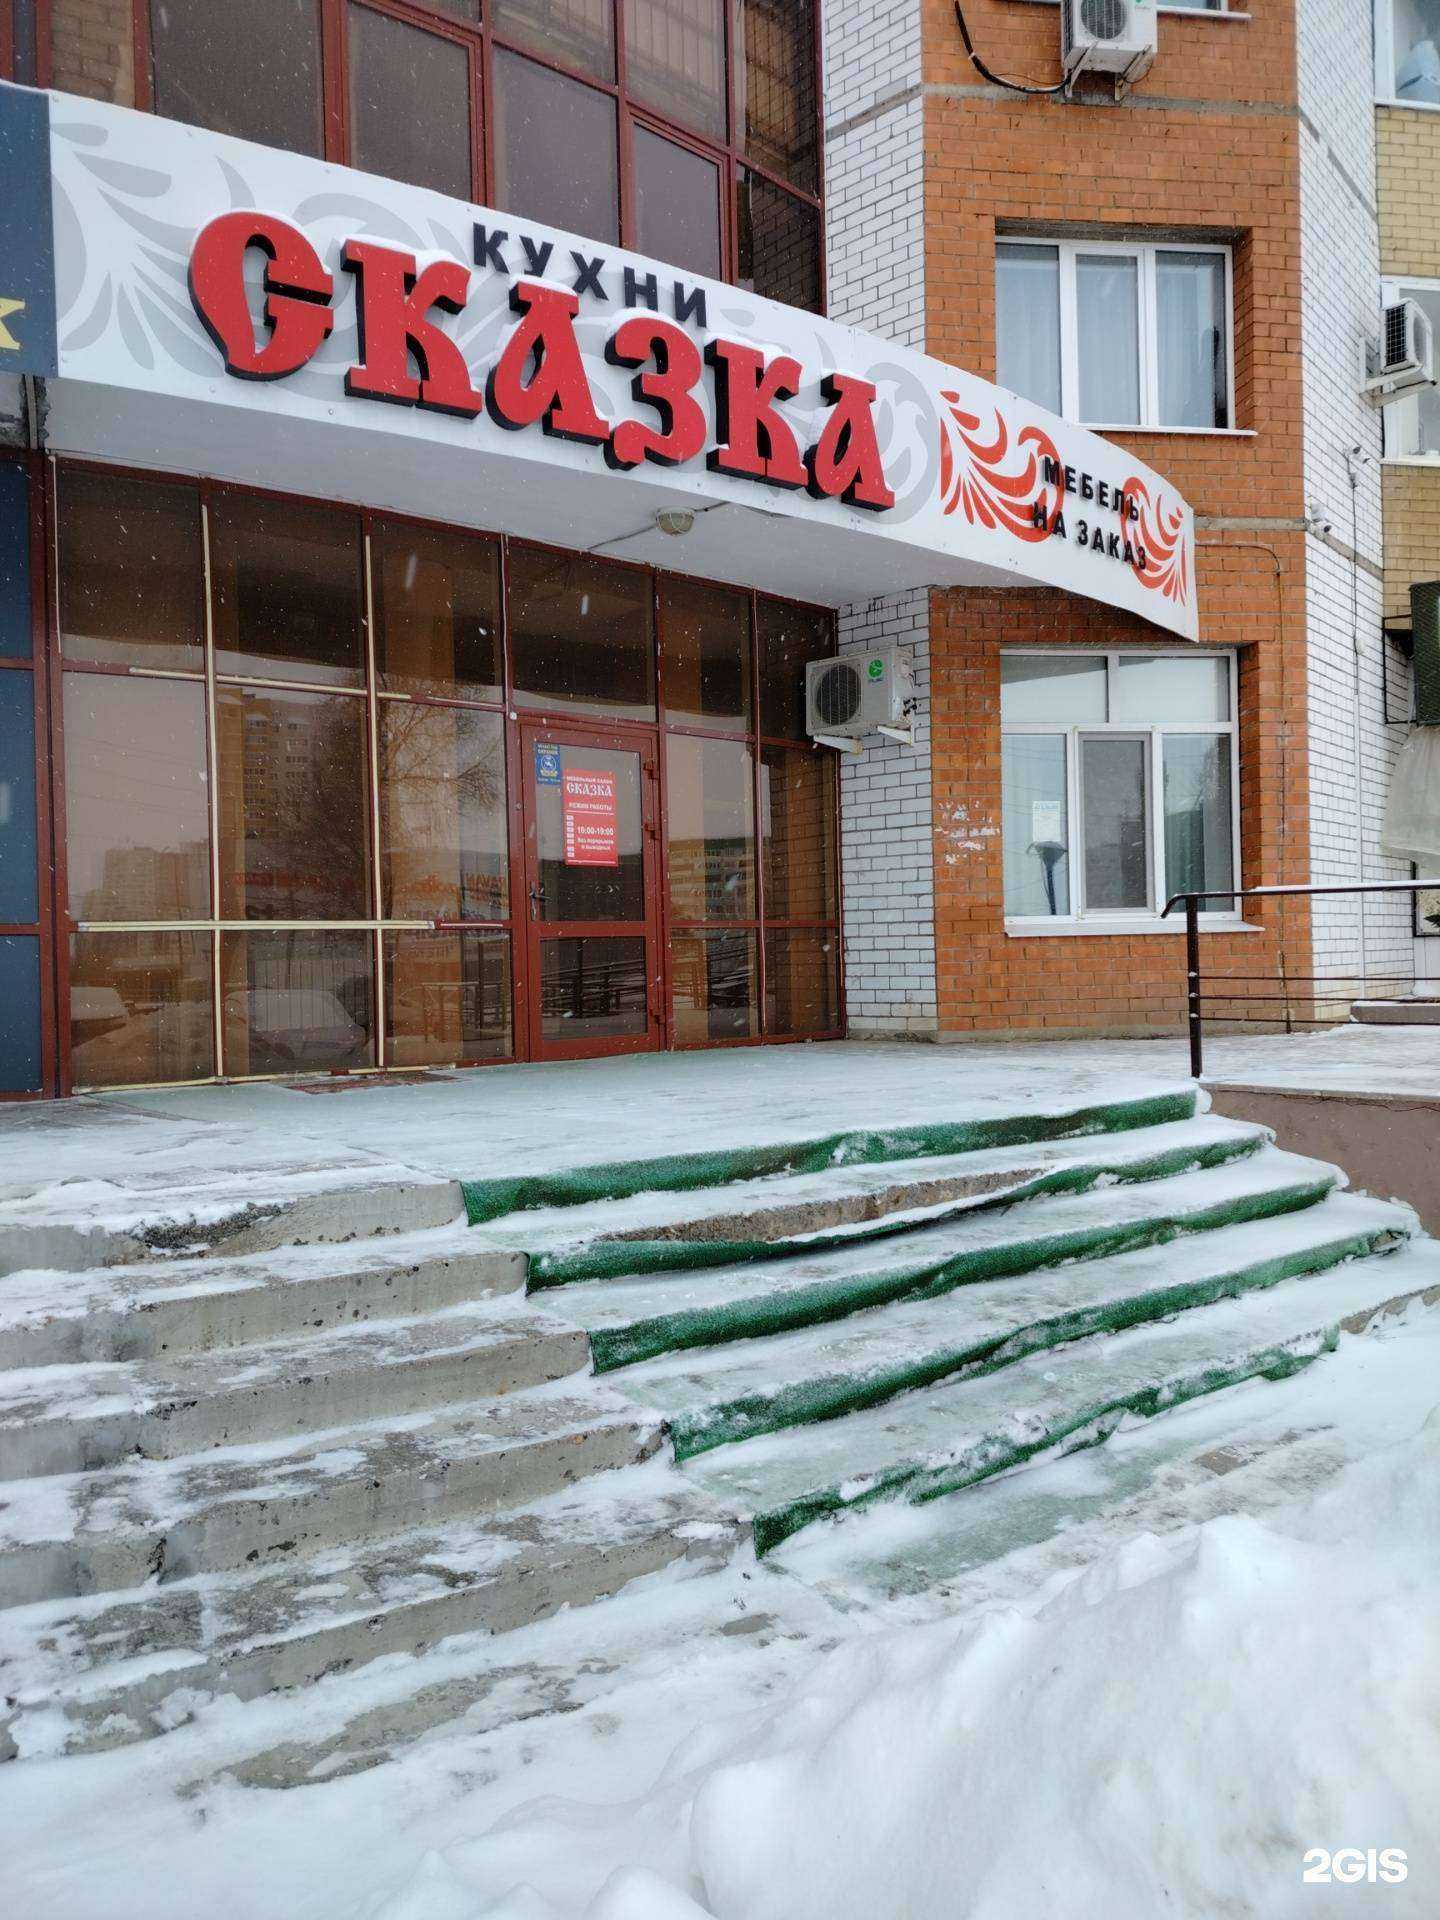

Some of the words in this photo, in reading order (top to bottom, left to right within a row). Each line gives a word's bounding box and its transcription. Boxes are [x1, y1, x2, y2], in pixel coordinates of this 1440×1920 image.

[472, 221, 708, 328] КУХНИ
[187, 210, 896, 512] СКАЗКА
[1042, 455, 1140, 522] МЕБЕЛЬ
[1031, 501, 1067, 540] НА
[1076, 519, 1147, 570] ЗАКАЗ
[566, 782, 613, 797] СКАЗКА
